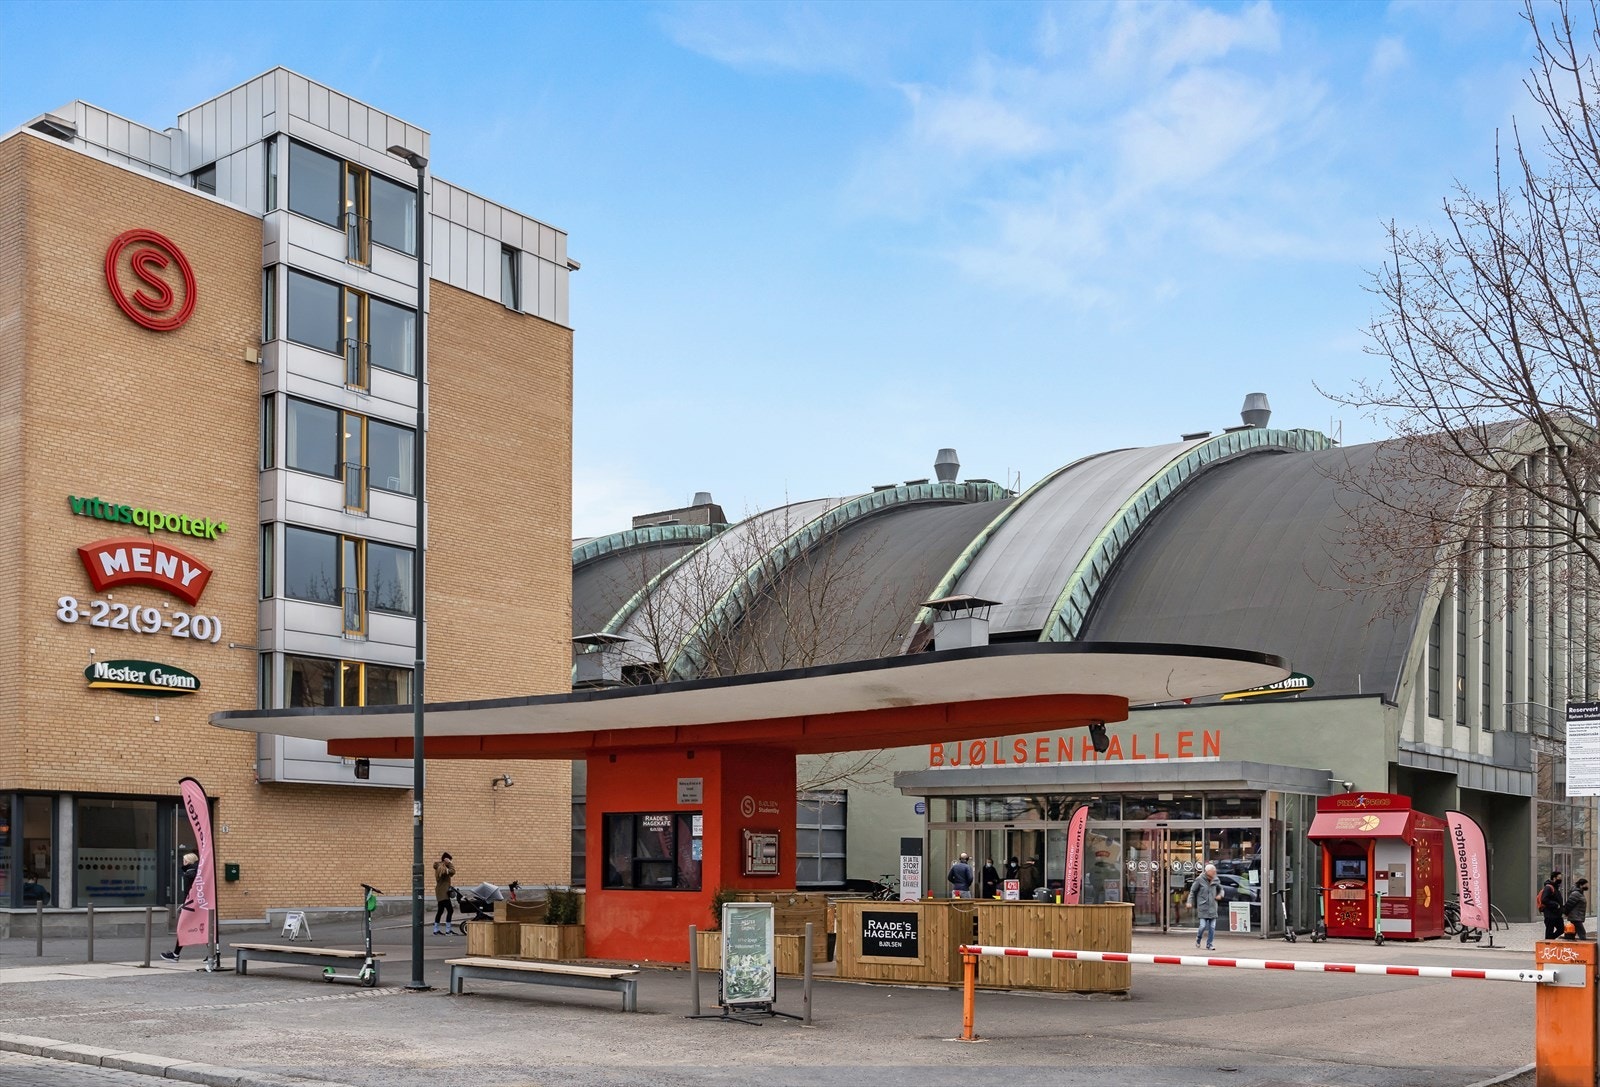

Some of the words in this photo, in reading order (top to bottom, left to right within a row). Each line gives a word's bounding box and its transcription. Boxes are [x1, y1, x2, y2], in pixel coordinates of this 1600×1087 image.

[98, 547, 202, 587] MENY
[57, 596, 222, 643] 8-22(9-20)
[93, 662, 147, 683] Mester
[149, 669, 196, 689] Grønn
[930, 730, 1221, 768] BJØLSENHALLEN
[1071, 817, 1083, 896] Vaksinesenter
[863, 929, 917, 940] HAGEKAFE
[868, 920, 912, 931] RAADE'S
